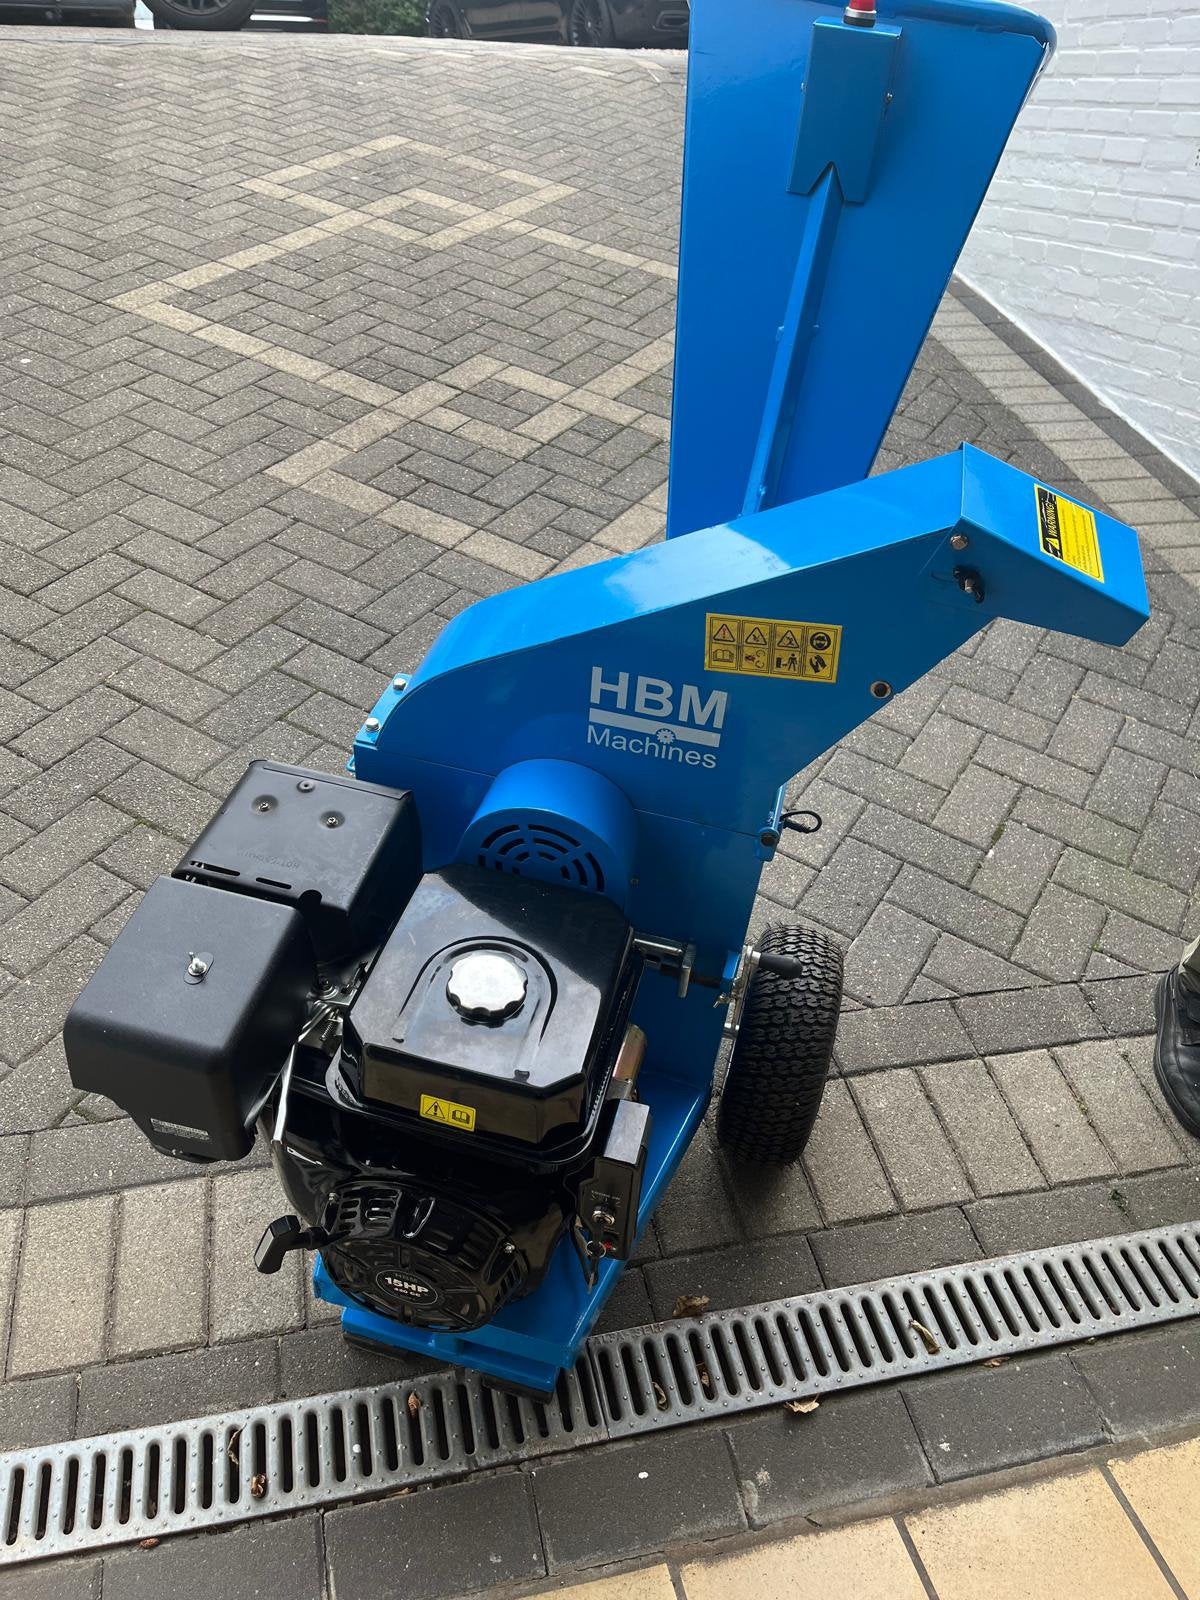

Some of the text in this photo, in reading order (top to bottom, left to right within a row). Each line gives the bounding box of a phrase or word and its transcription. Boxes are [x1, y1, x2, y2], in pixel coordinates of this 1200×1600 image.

[590, 666, 728, 729] HBM
[586, 724, 718, 769] Machines
[385, 1276, 429, 1293] 15HP
